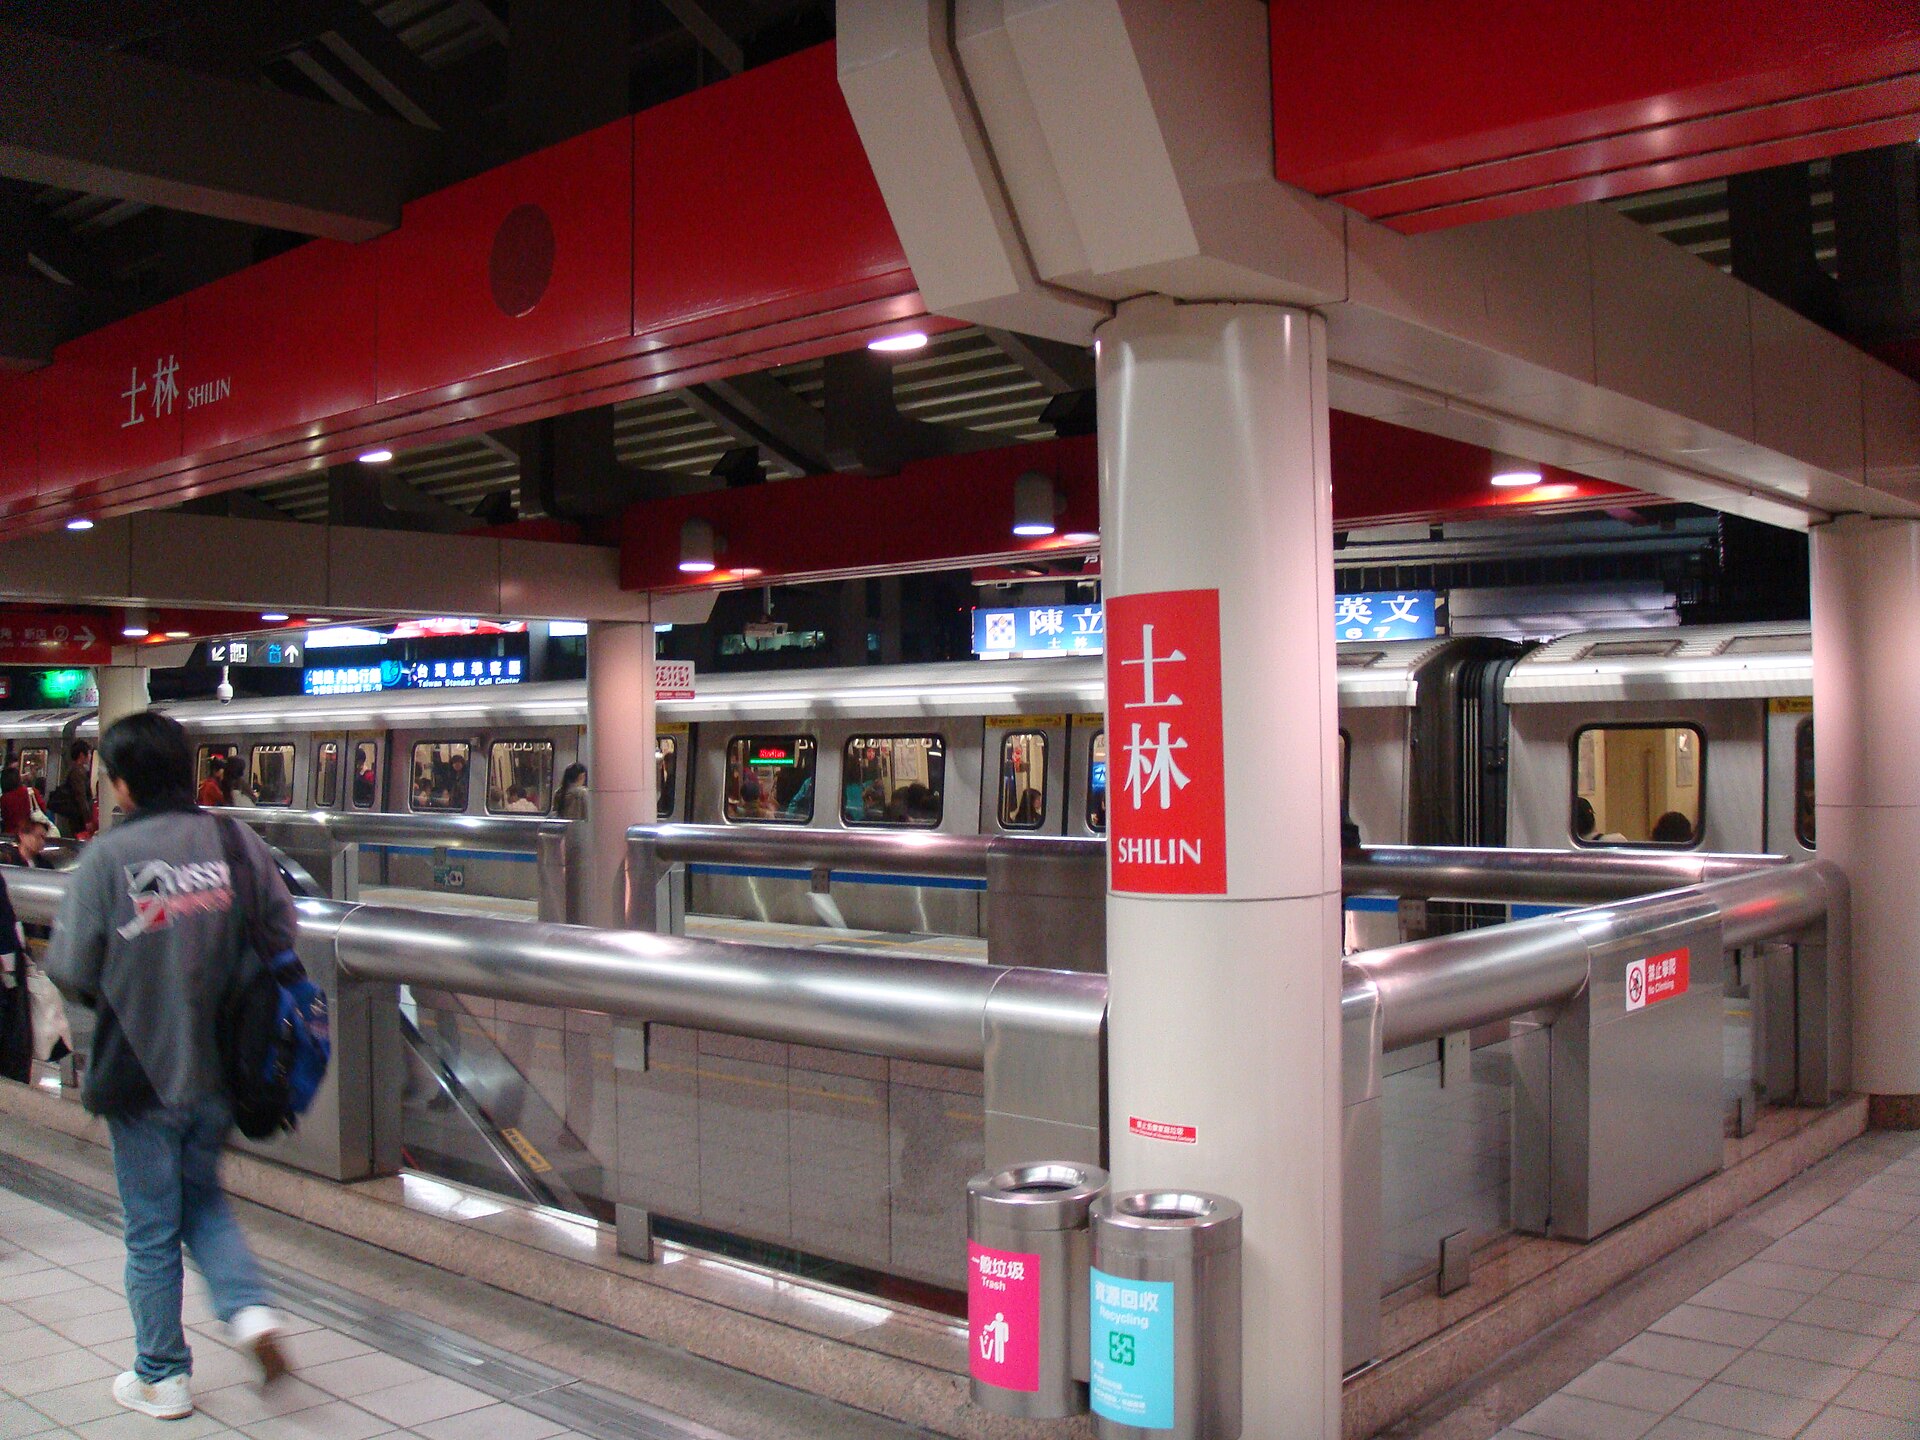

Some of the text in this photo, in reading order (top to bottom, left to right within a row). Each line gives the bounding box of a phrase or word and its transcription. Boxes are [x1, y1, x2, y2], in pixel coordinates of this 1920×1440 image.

[121, 355, 231, 428] 士林 SHILIN
[1029, 595, 1420, 636] 陳立 英文
[417, 679, 443, 687] Taiwan
[445, 678, 476, 687] Standard
[479, 677, 493, 686] Call
[1121, 624, 1191, 810] 士林
[1118, 837, 1201, 865] SHILIN
[971, 1255, 1025, 1281] 一般垃圾
[981, 1275, 1006, 1292] Trash
[1099, 1305, 1149, 1329] Recycling
